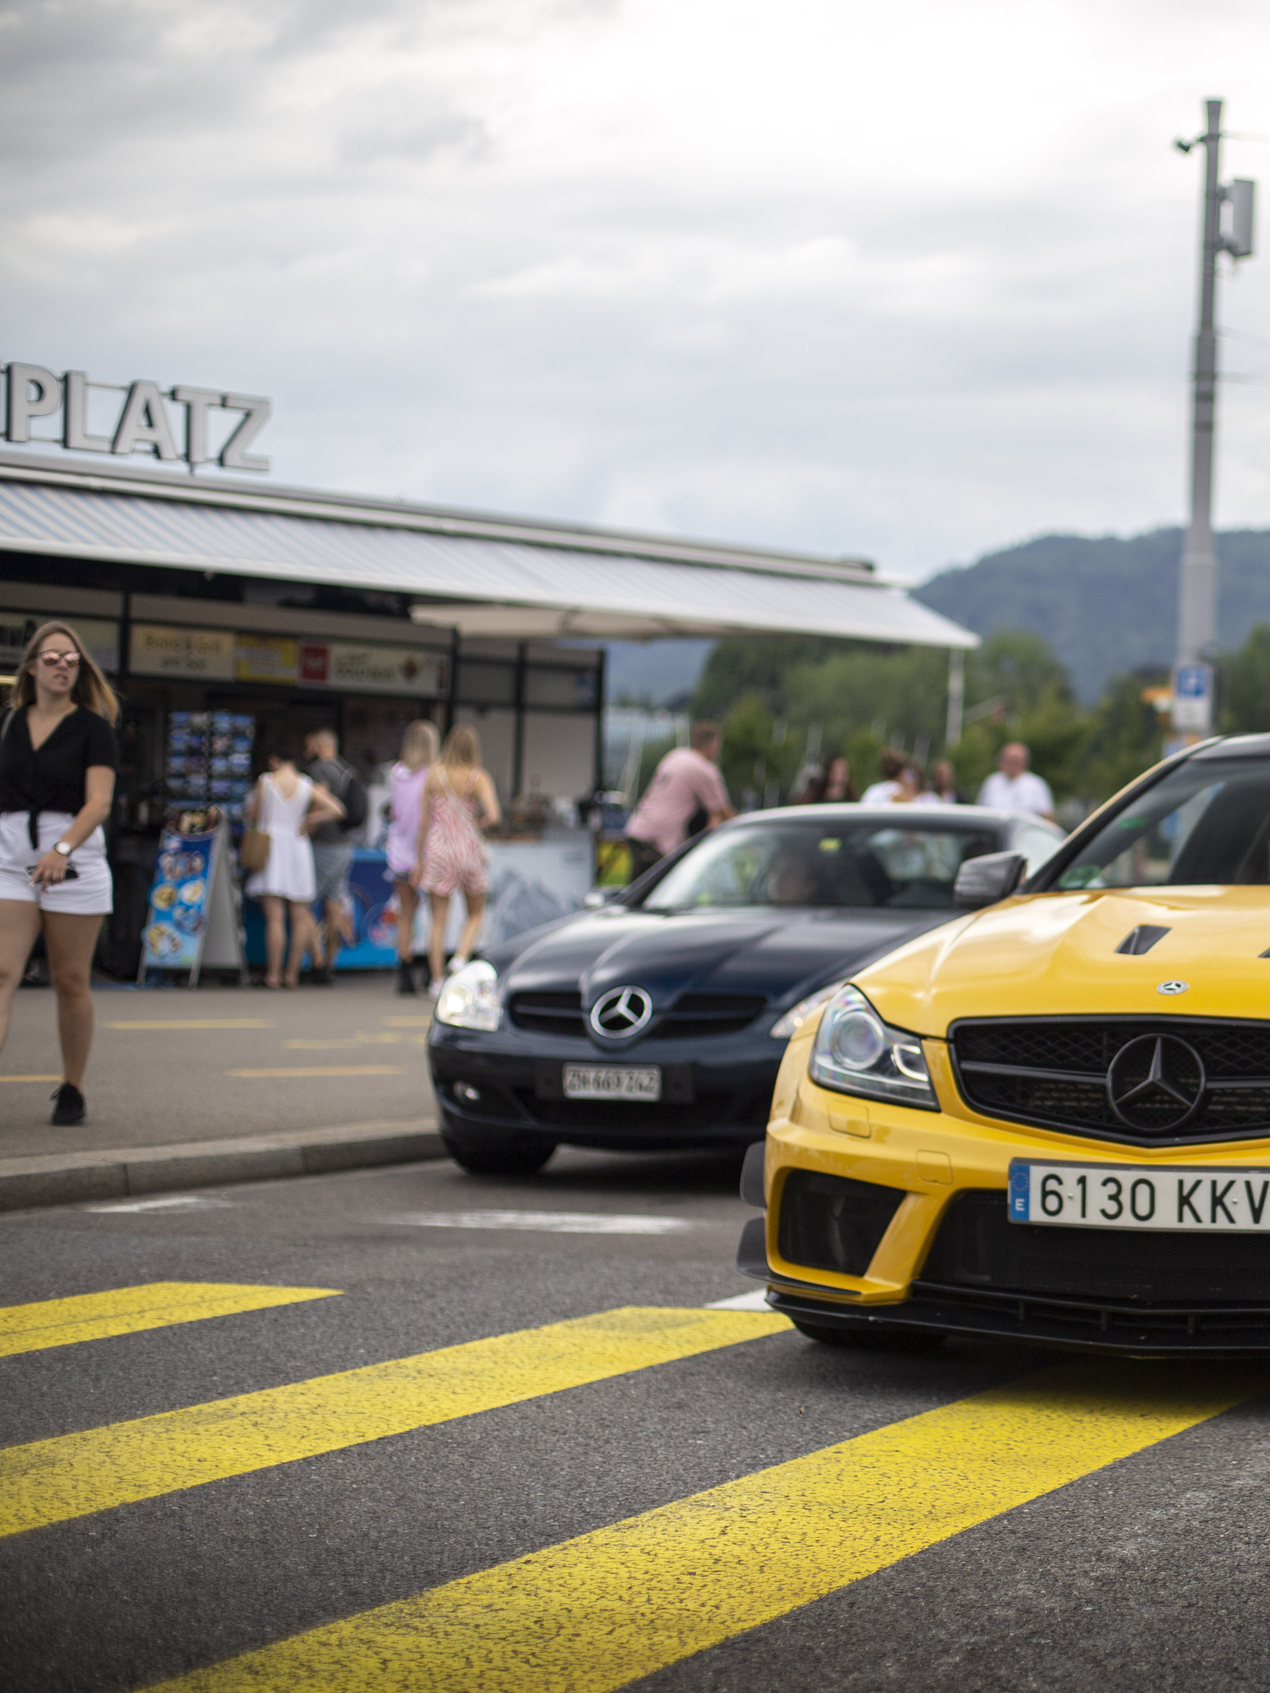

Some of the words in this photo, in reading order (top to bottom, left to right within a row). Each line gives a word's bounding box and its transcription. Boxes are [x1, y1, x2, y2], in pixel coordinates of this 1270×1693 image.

[5, 361, 272, 472] PLATZ
[1015, 1198, 1025, 1211] E
[1040, 1173, 1156, 1222] 6130
[1177, 1179, 1270, 1225] KKV
